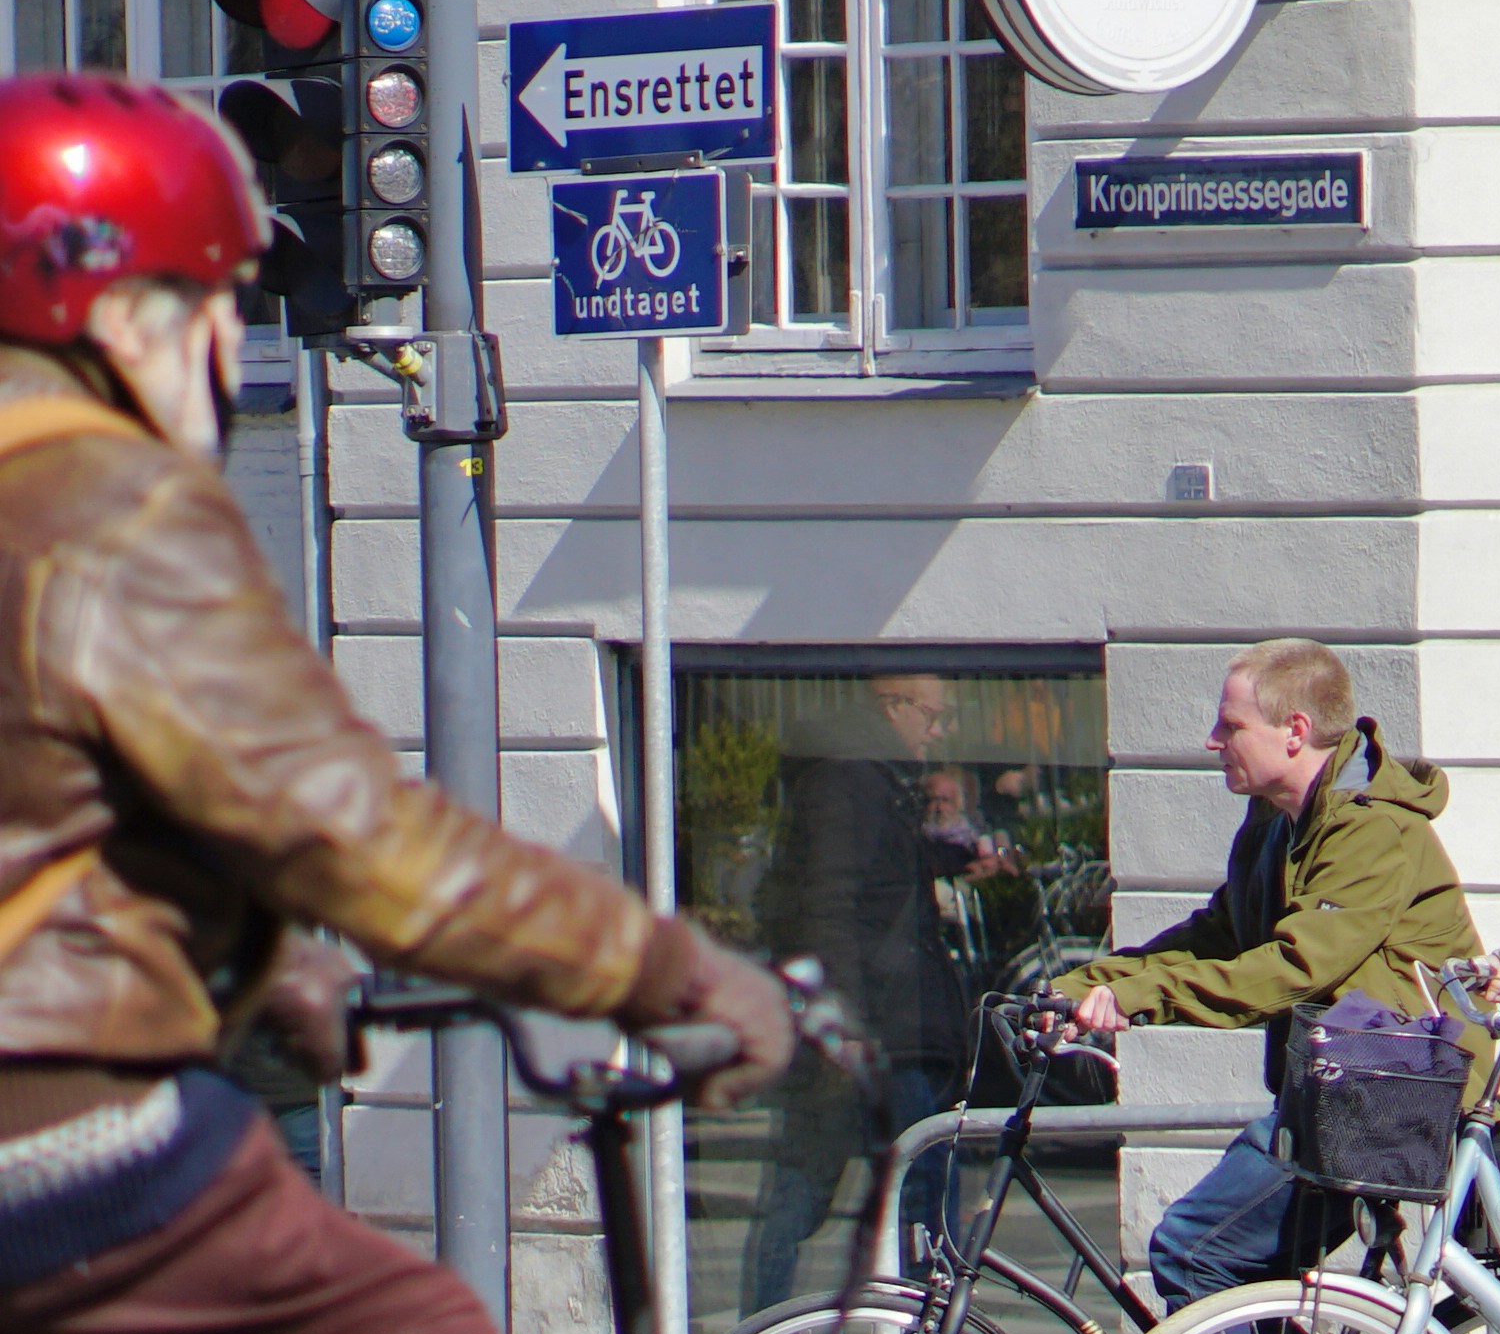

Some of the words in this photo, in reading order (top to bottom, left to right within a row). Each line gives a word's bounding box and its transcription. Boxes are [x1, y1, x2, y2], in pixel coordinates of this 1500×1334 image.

[564, 58, 755, 119] Ensrettet
[1088, 169, 1349, 219] Kronprinsessegade
[575, 283, 701, 321] undtaget
